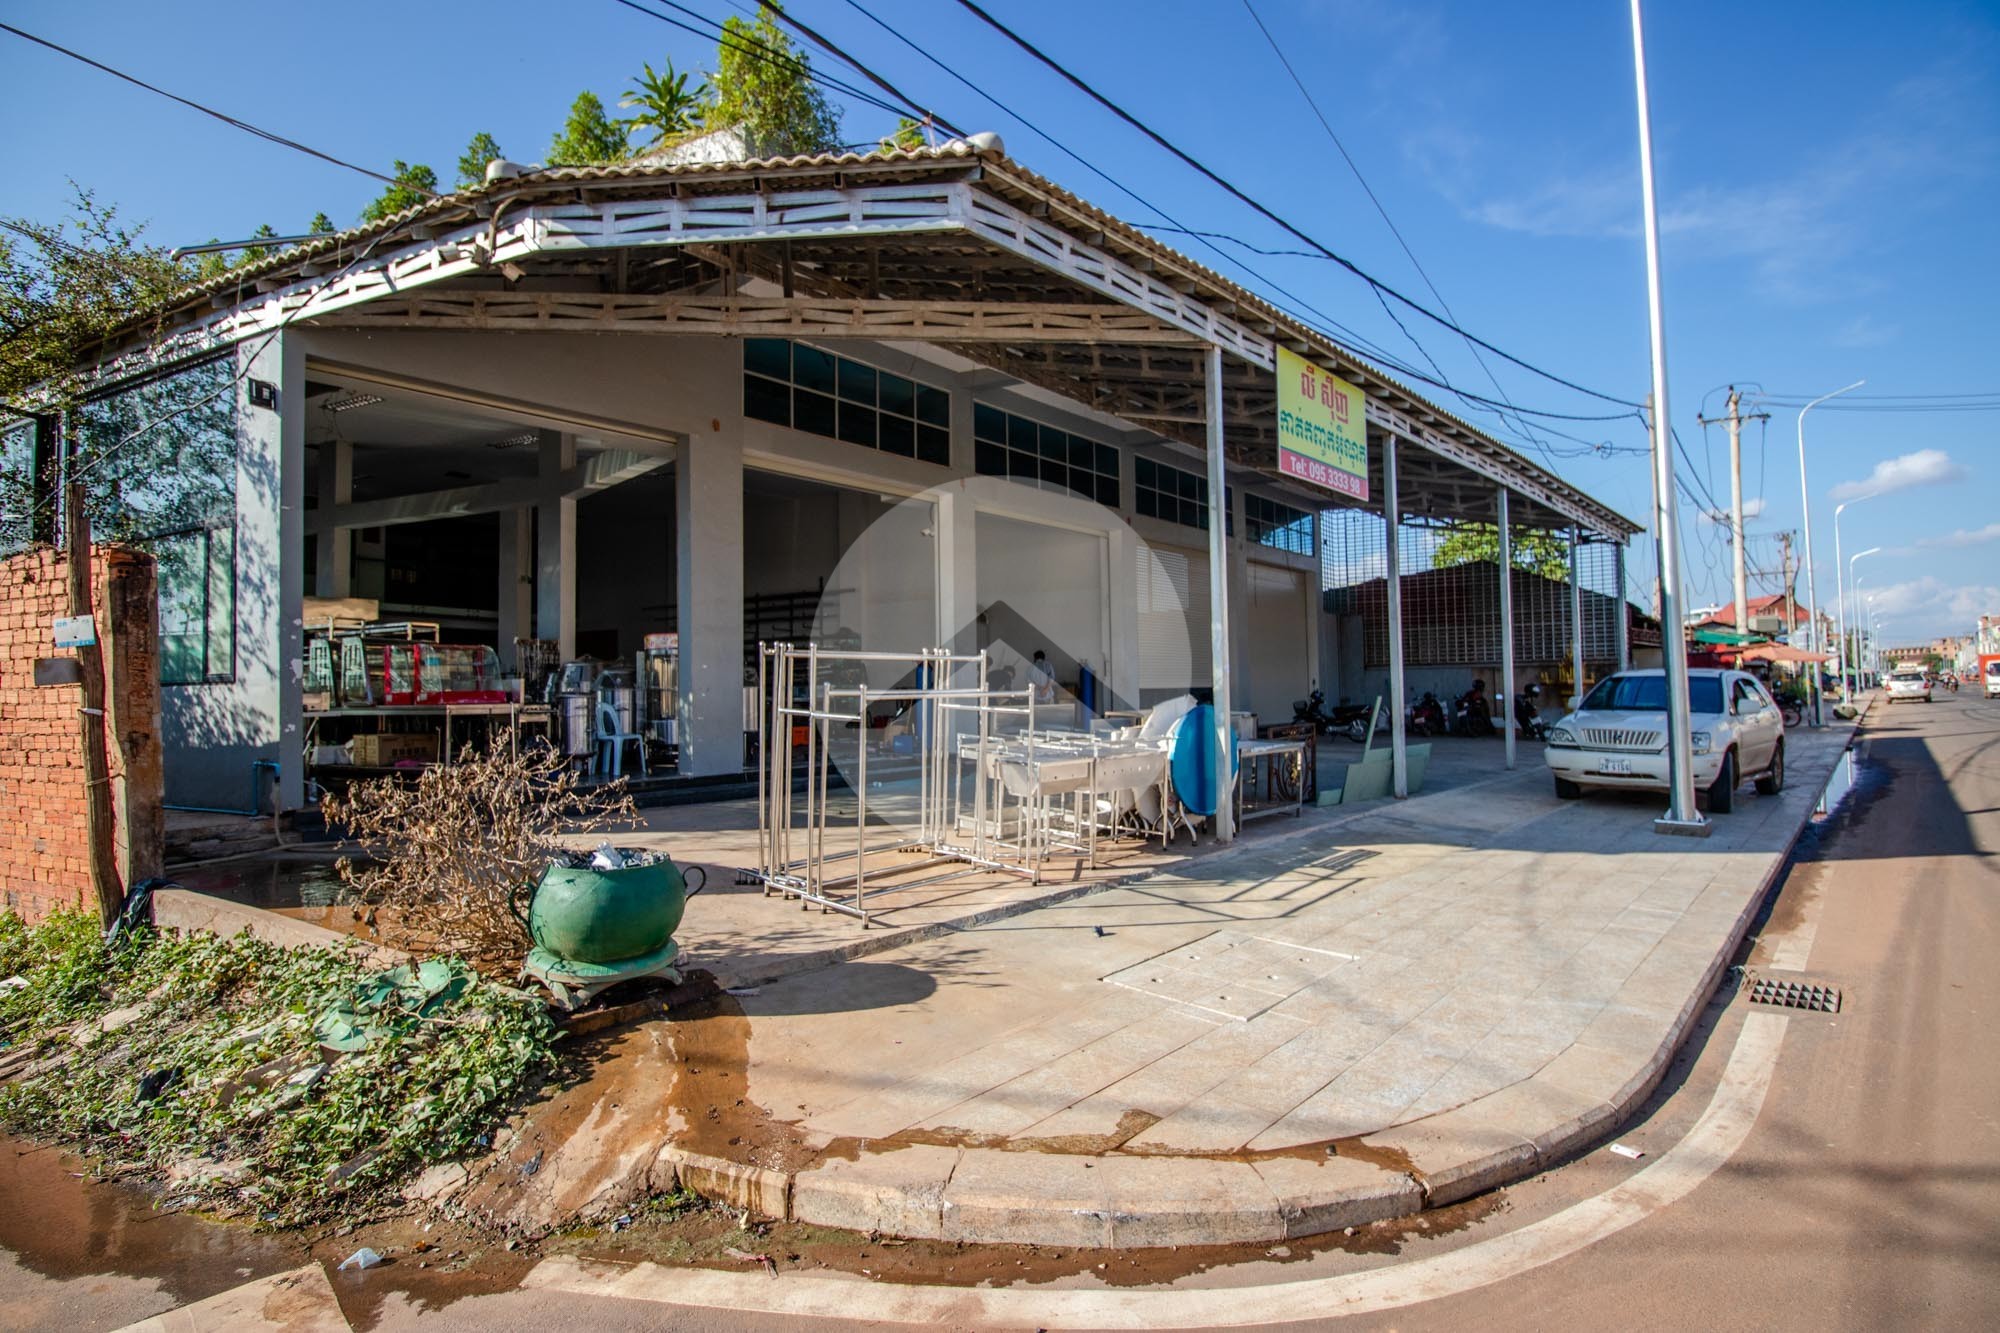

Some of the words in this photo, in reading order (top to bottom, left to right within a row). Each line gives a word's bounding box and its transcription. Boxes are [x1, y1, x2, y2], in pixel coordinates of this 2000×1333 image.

[1290, 456, 1306, 475] Tel:
[1309, 461, 1326, 482] 095
[1328, 470, 1349, 490] 3333
[1350, 478, 1361, 495] 98
